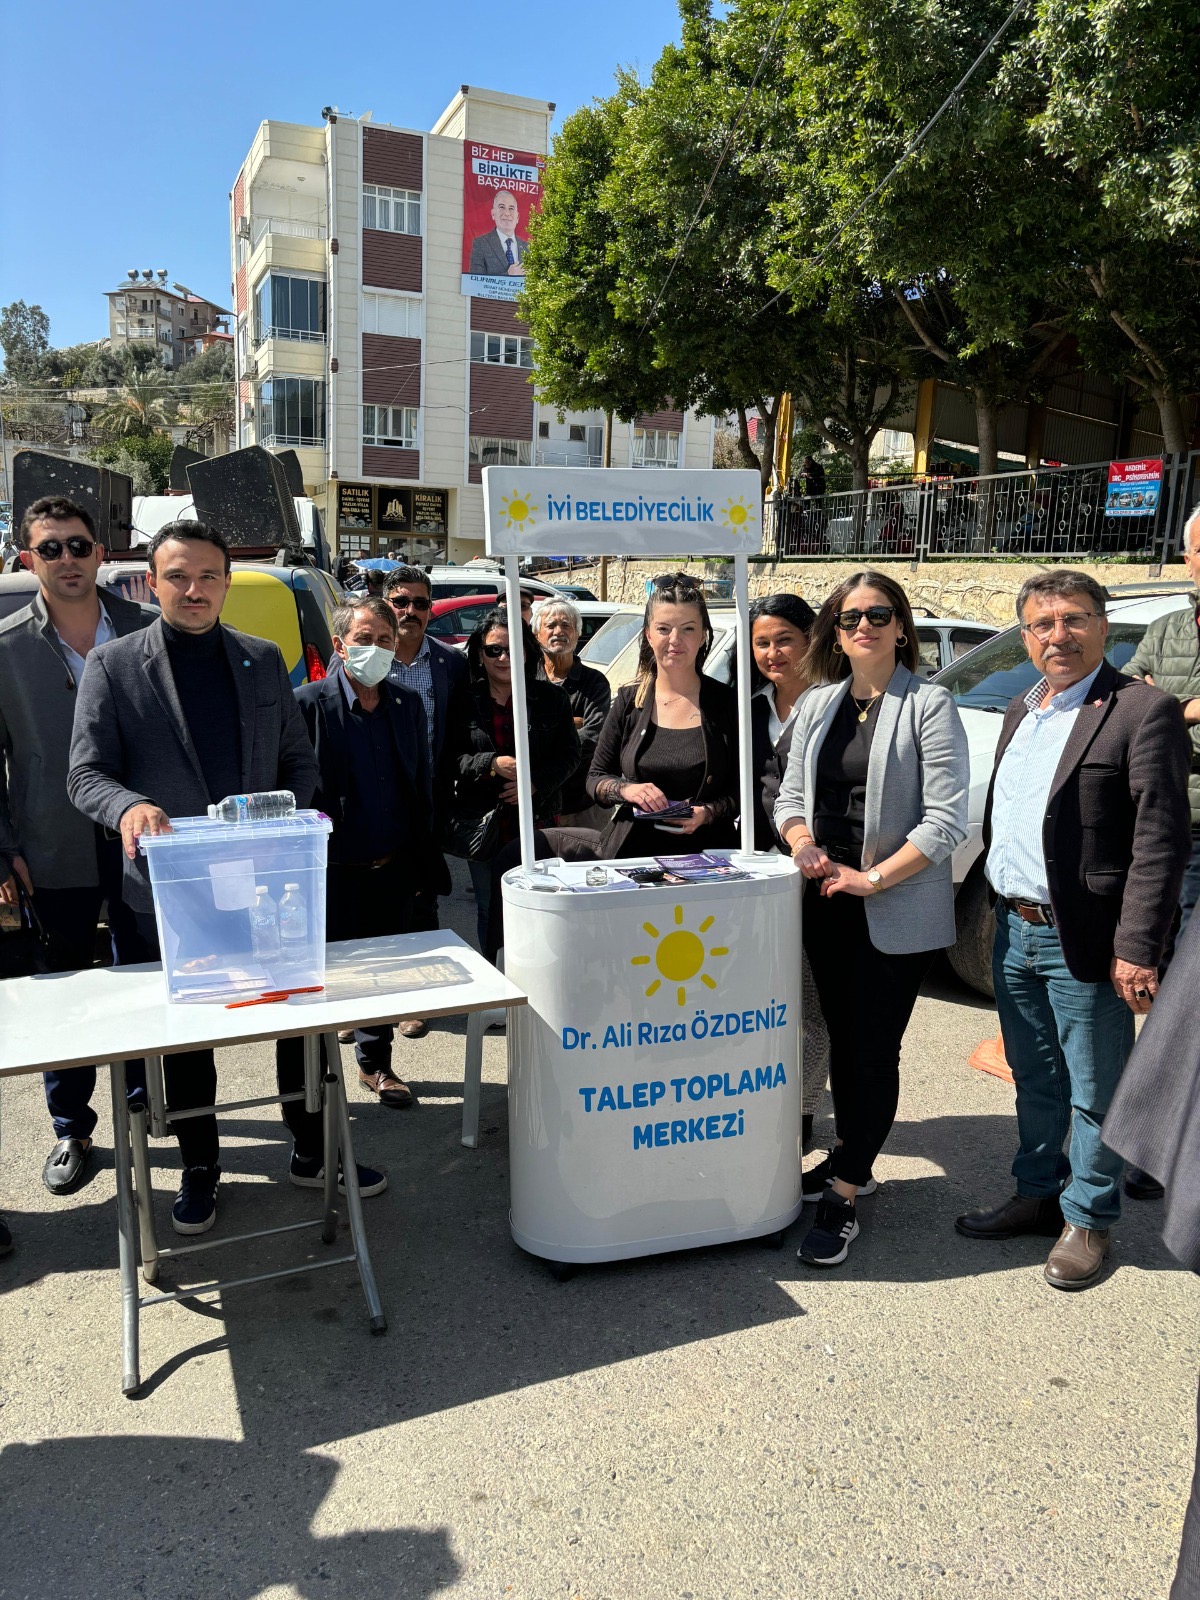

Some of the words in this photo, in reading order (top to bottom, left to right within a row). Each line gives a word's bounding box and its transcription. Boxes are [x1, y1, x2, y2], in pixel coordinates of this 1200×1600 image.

[472, 146, 489, 158] BİZ
[492, 149, 514, 162] HEP
[478, 161, 532, 181] BİRLİKTE
[478, 176, 538, 194] BAŞARIRIZ!
[471, 276, 506, 286] DURMUŞ
[342, 488, 369, 496] SATILIK
[416, 494, 442, 502] KİRALIK
[548, 494, 571, 520] İYİ
[576, 495, 714, 522] BELEDİYECİLİK
[562, 1027, 596, 1050] Dr.
[602, 1022, 632, 1048] Ali
[638, 1022, 686, 1045] Rıza
[691, 999, 787, 1039] ÖZDENİZ
[579, 1081, 666, 1112] TALEP
[670, 1062, 786, 1103] TOPLAMA
[633, 1109, 744, 1150] MERKEZİ
